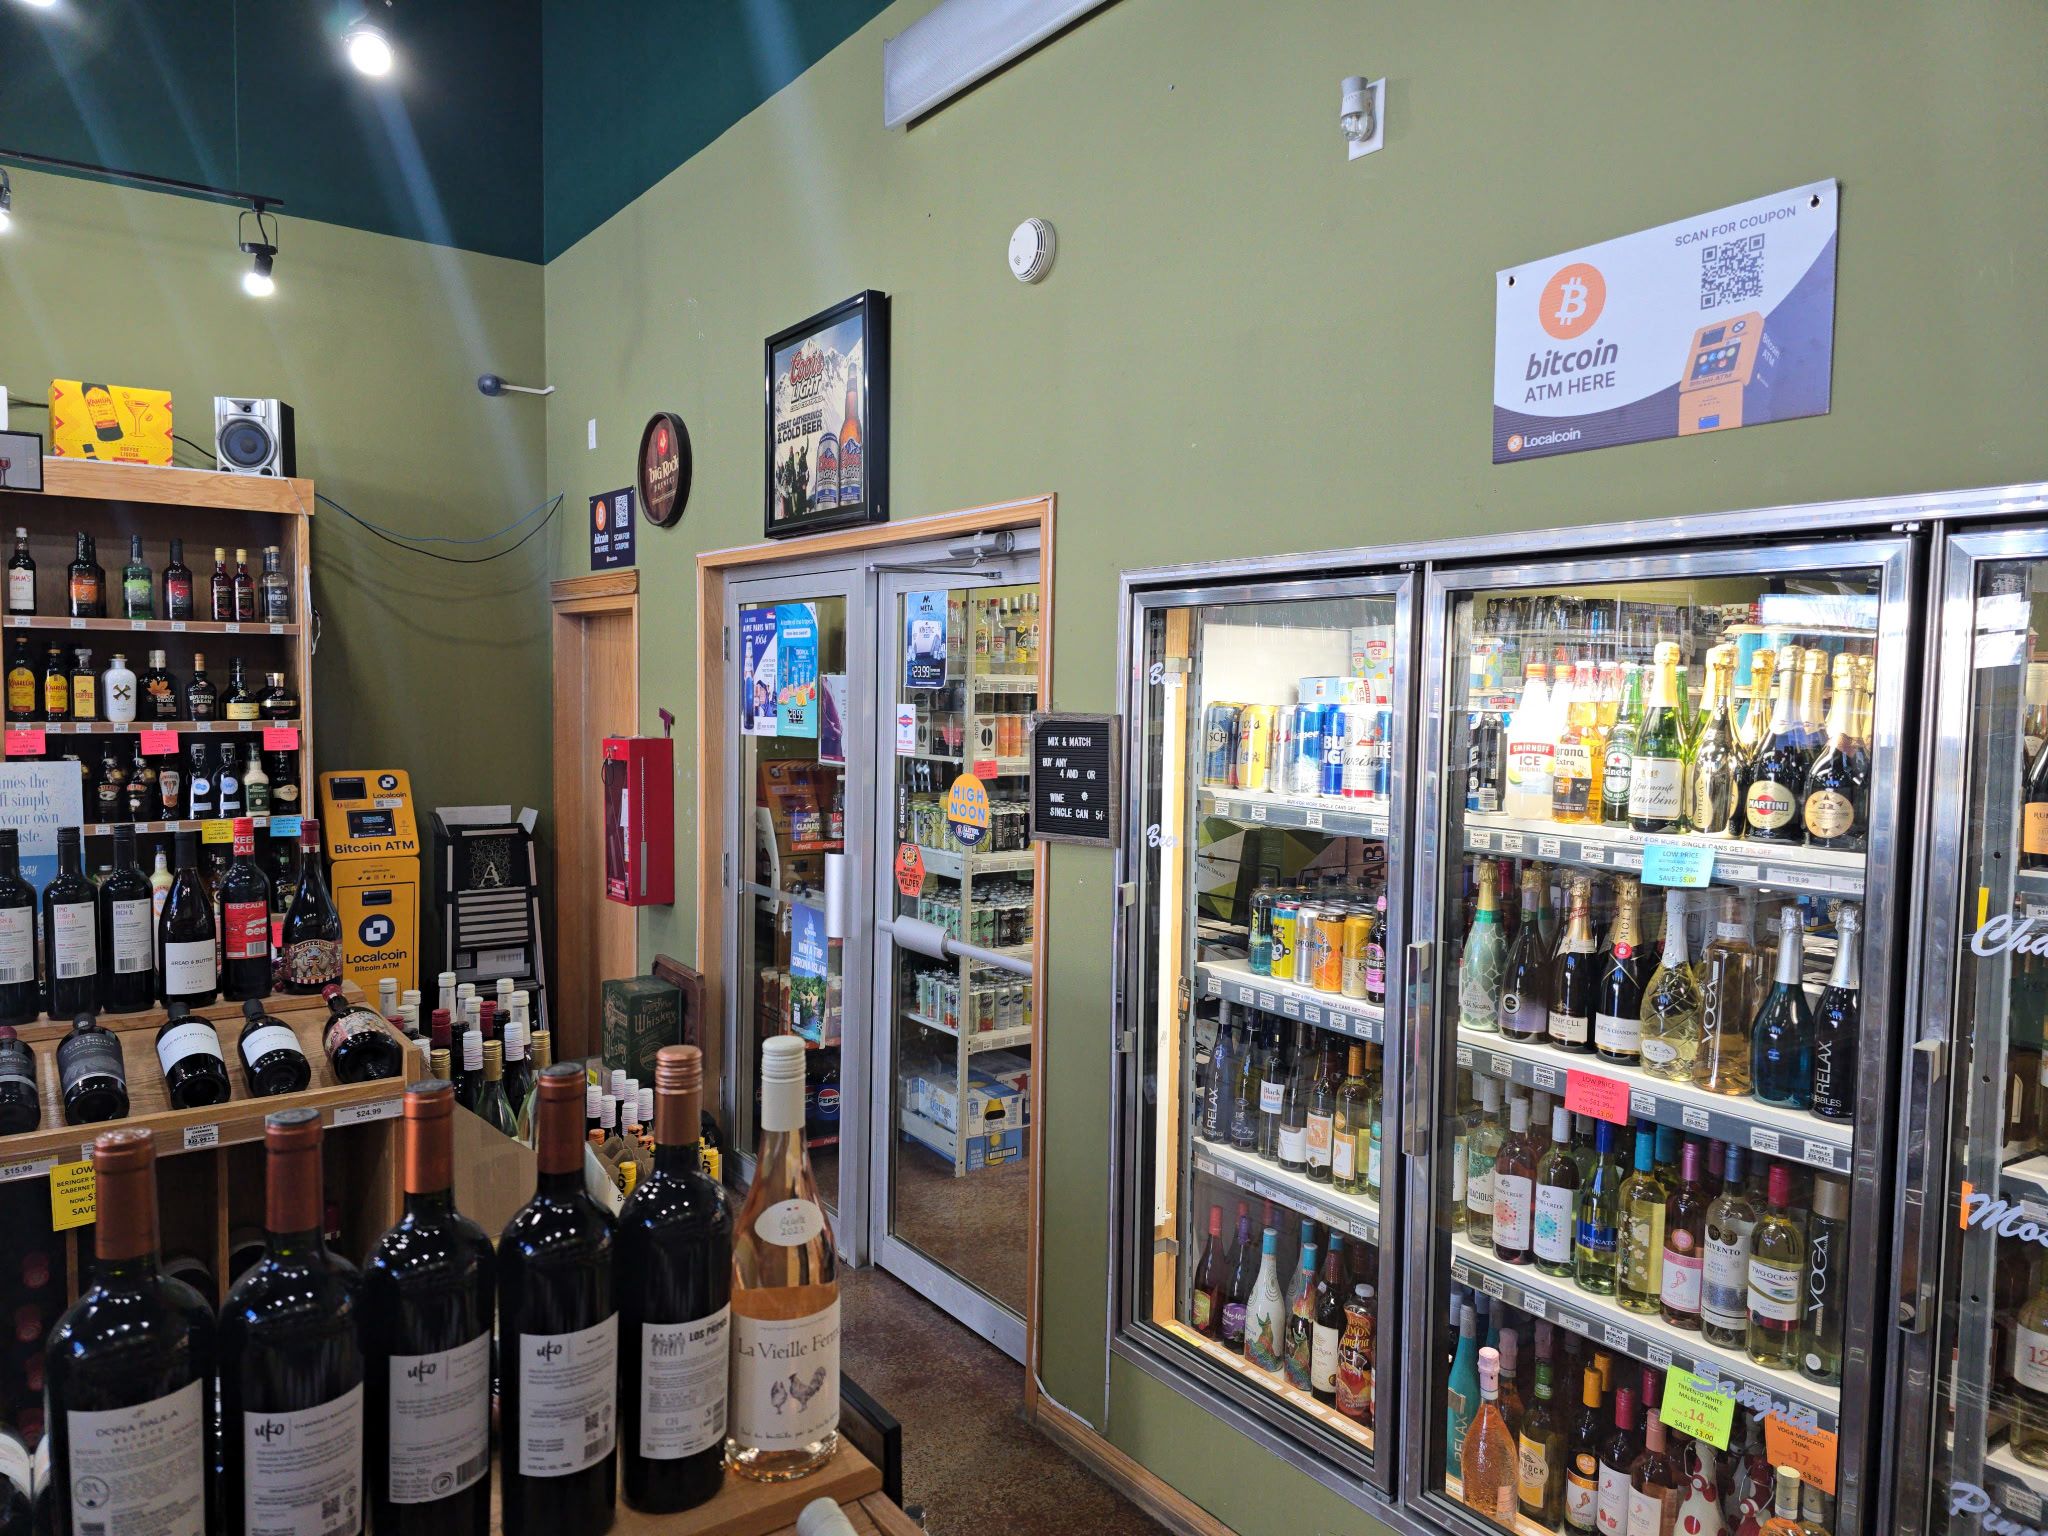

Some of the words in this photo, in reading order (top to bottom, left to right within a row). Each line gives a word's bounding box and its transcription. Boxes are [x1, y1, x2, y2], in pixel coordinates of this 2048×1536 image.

[1675, 229, 1708, 247] SCAN
[1711, 221, 1736, 238] FOR
[1739, 206, 1796, 229] COUPON
[1525, 338, 1618, 381] bitcoin
[791, 374, 822, 404] LIGHT
[1524, 382, 1563, 403] ATM
[1568, 371, 1617, 395] HERE
[777, 415, 792, 432] GREAT
[783, 425, 800, 442] COLD
[802, 419, 822, 436] BEER
[1524, 428, 1581, 448] Localcoin
[920, 604, 933, 612] META
[1048, 737, 1059, 746] MIX
[1062, 737, 1067, 747] &
[1069, 737, 1091, 747] MATCH
[1209, 731, 1228, 743] SCH
[1324, 735, 1344, 750] BU
[1512, 743, 1551, 753] SMIRNOFF
[1043, 758, 1052, 767] BUY
[1056, 758, 1068, 768] ANY
[1519, 755, 1541, 766] ICE
[30, 773, 48, 788] the
[1060, 769, 1064, 778] 4
[1066, 770, 1079, 779] AND
[1087, 770, 1096, 780] OR
[12, 791, 50, 811] simply
[373, 791, 407, 799] Localcoin
[953, 785, 984, 804] HIGH
[1050, 793, 1065, 803] WINE
[950, 801, 985, 822] NOON
[1749, 799, 1788, 811] MARTINI
[1, 815, 30, 825] your
[33, 814, 59, 823] own
[1050, 807, 1072, 818] SINGLE
[1076, 809, 1089, 819] CAN
[1147, 823, 1178, 848] Beer
[334, 841, 381, 854] Bitcoin
[385, 840, 415, 850] ATM
[1660, 838, 1680, 846] MORE
[1682, 840, 1706, 849] SINGLE
[1708, 843, 1727, 851] CANS
[1662, 850, 1680, 858] LOW
[1681, 851, 1700, 859] PRICE
[900, 878, 920, 889] WILDER
[1658, 875, 1677, 883] SAVE:
[1787, 875, 1809, 884] $19.99
[1971, 914, 2048, 957] Cha
[346, 949, 407, 965] Localcoin
[354, 964, 382, 973] Bitcoin
[383, 961, 400, 970] ATM
[1701, 981, 1718, 1044] VOGA
[634, 1010, 676, 1035] Whiskey
[1816, 1041, 1833, 1095] RELAX
[1582, 1075, 1597, 1084] LOW
[1597, 1080, 1615, 1089] PRICE
[1263, 1087, 1281, 1096] Black
[356, 1108, 382, 1118] $24.99
[1207, 1088, 1218, 1130] RELAX
[4, 1165, 33, 1176] $15.99
[57, 1177, 90, 1188] BERINGER
[60, 1184, 95, 1195] CABERNET
[1705, 1241, 1740, 1256] RIVENTO
[1752, 1266, 1766, 1277] TWO
[1766, 1272, 1798, 1282] OCEANS
[1809, 1235, 1829, 1311] VOGA
[689, 1327, 705, 1342] LOS
[738, 1337, 755, 1357] La
[758, 1340, 808, 1360] Vieille
[1678, 1383, 1704, 1399] TRIVENTO
[1706, 1394, 1723, 1406] WHITE
[1679, 1392, 1700, 1406] MALBEC
[1674, 1420, 1693, 1432] SAVE:
[1695, 1429, 1714, 1441] $3.00
[1776, 1425, 1794, 1438] VOGA
[1794, 1432, 1824, 1448] MOSCATO
[1803, 1471, 1822, 1485] $3.00
